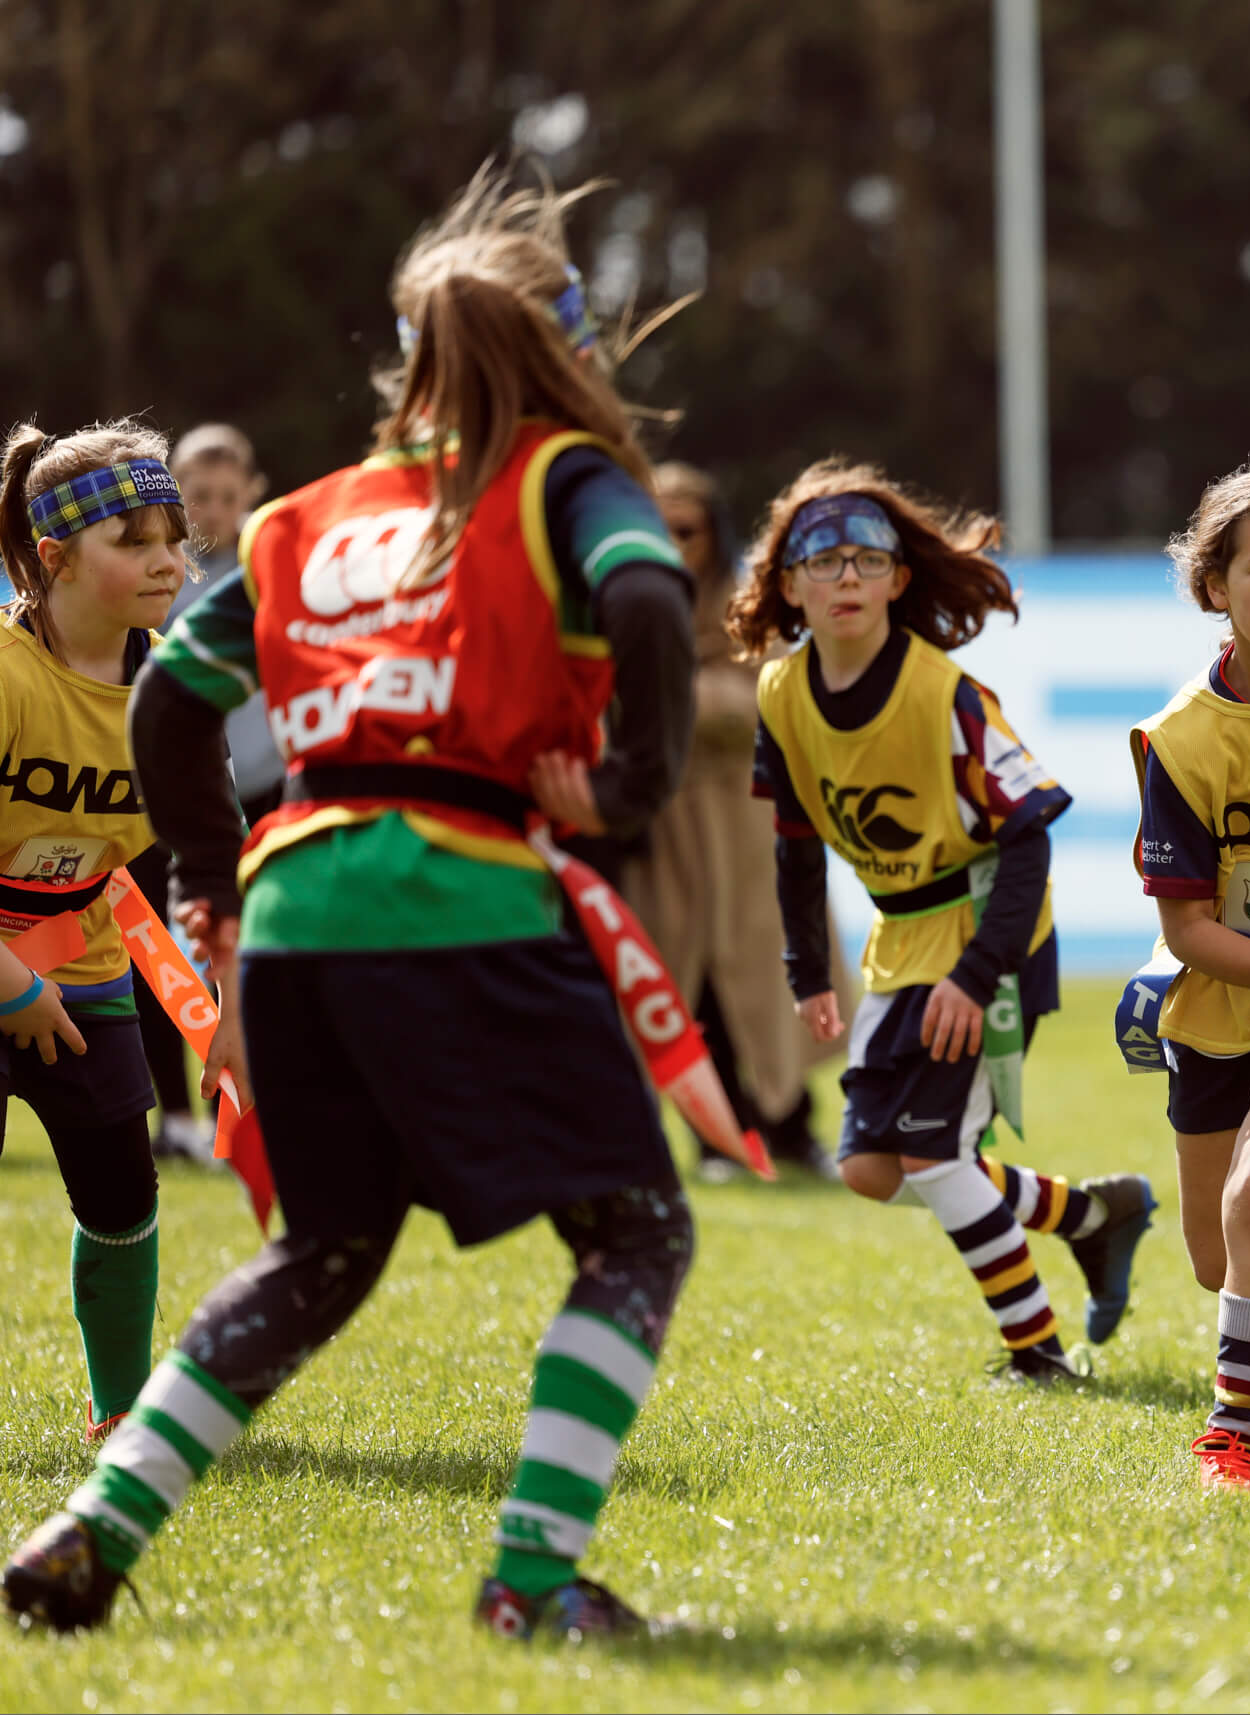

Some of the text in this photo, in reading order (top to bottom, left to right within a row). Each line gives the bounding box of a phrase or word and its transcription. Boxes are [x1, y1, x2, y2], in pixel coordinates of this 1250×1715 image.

[130, 468, 147, 480] MY
[136, 481, 177, 492] DODDIE
[270, 657, 456, 752] HOWEN
[0, 751, 146, 815] HOWD
[1143, 851, 1174, 864] ebster
[0, 915, 33, 928] INCIPAL
[125, 919, 217, 1030] TAG
[578, 883, 685, 1044] TAG
[1121, 981, 1161, 1061] TAG
